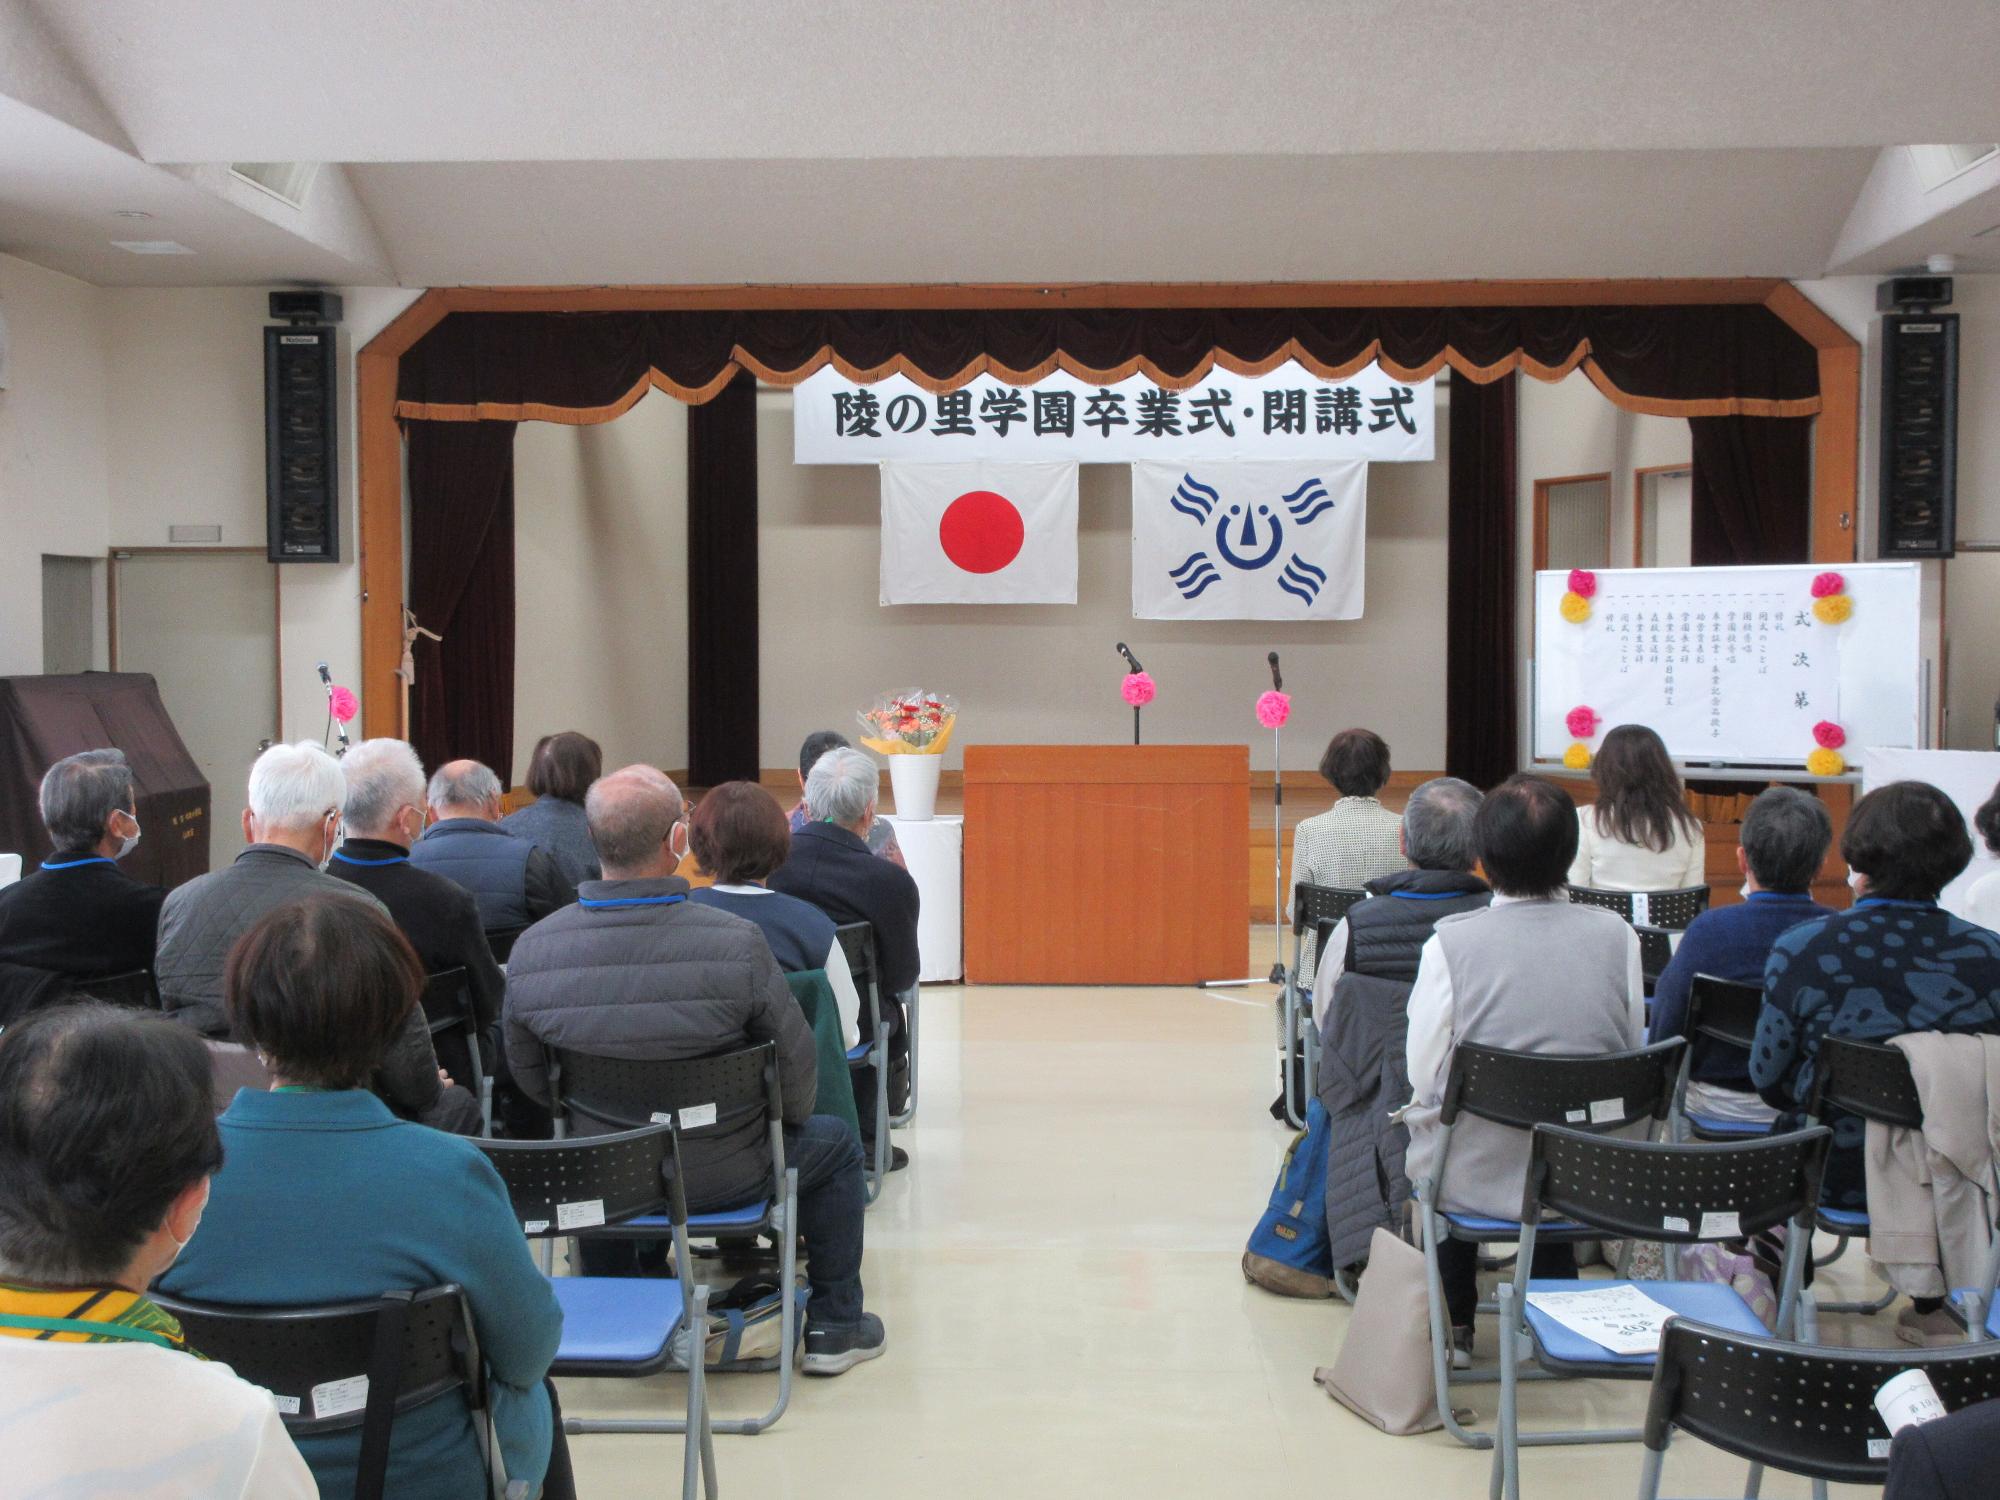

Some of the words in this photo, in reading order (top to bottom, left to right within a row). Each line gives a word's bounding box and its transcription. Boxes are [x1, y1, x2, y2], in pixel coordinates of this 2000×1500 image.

[833, 386, 1417, 438] 陵の里学園卒業式・閉講式
[1792, 610, 1812, 710] 式次第
